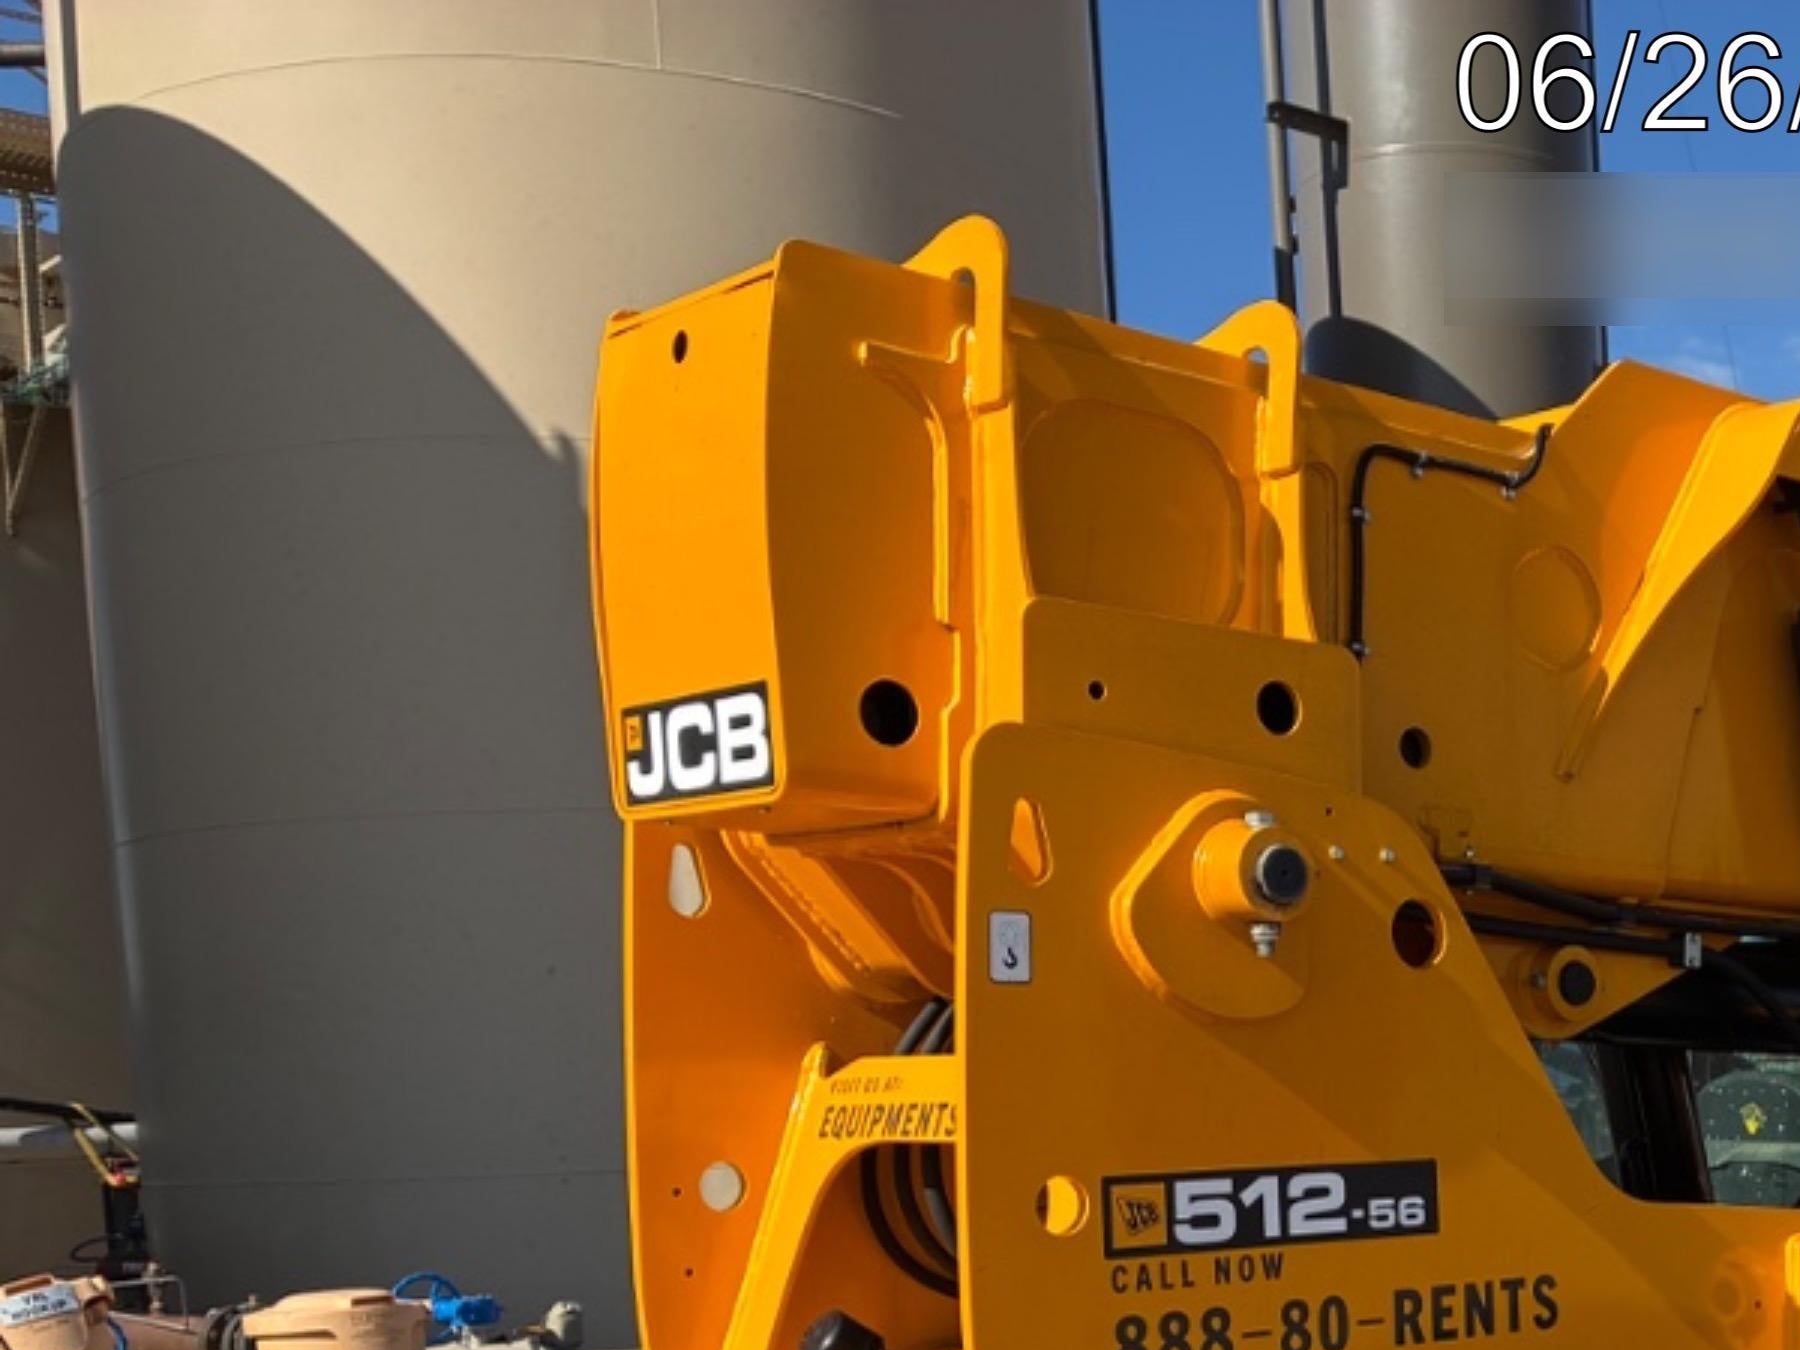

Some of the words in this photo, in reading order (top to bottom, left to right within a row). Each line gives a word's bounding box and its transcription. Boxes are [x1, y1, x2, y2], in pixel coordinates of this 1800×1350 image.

[627, 691, 769, 798] JCB
[1111, 1259, 1195, 1294] CALL
[1214, 1253, 1285, 1286] NOW
